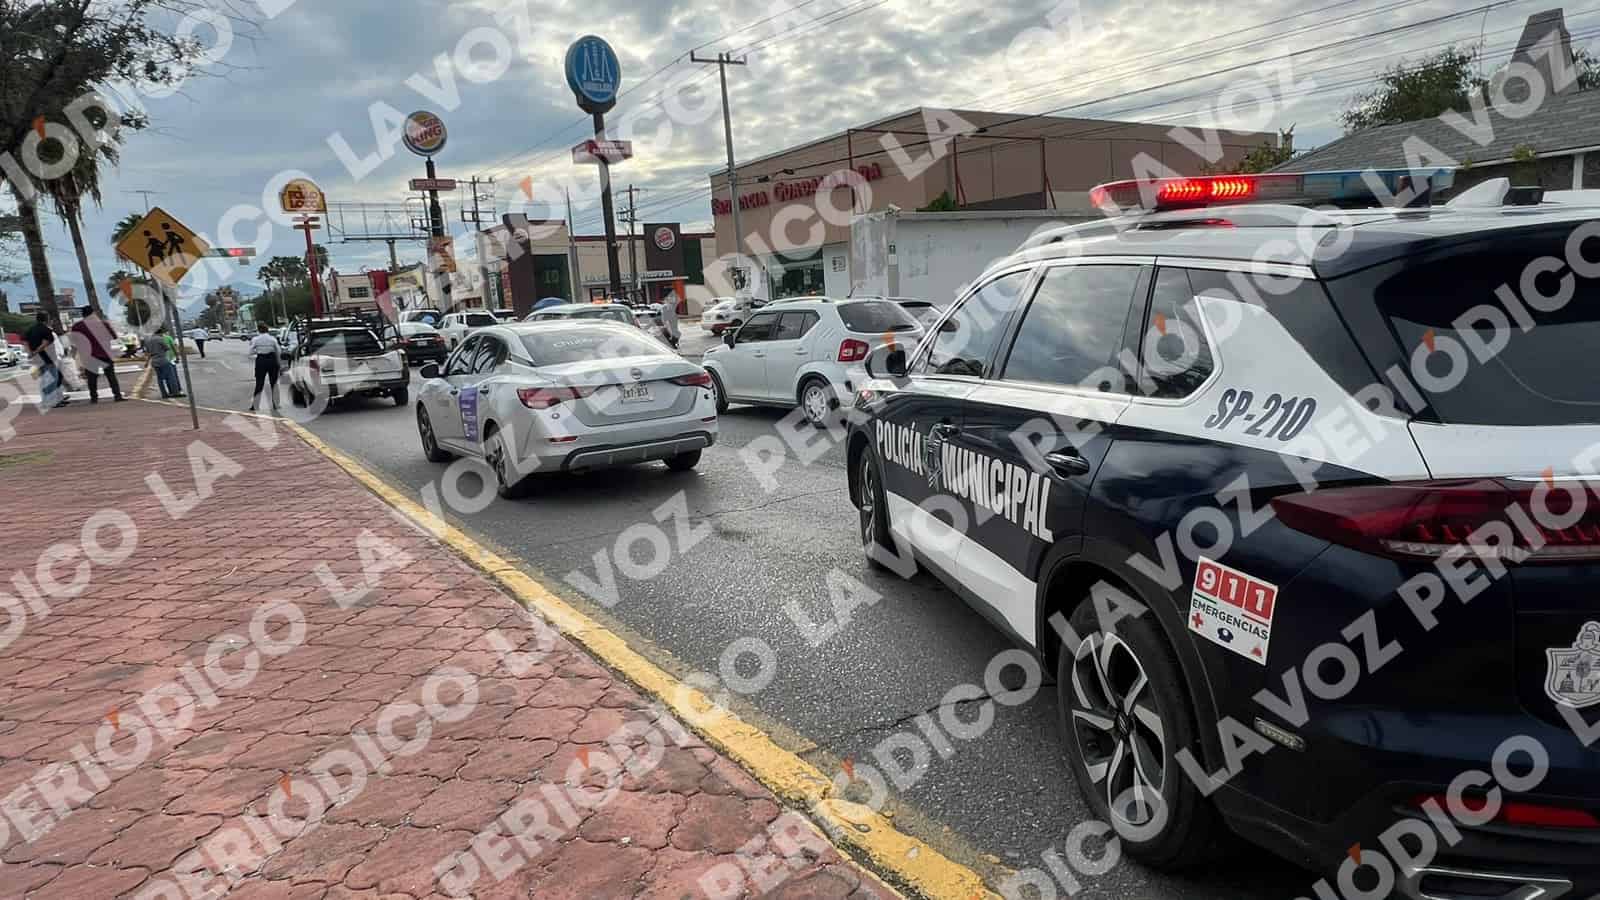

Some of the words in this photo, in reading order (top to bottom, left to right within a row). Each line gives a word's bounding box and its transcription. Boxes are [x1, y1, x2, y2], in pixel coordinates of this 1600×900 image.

[711, 191, 768, 216] FARACIA
[1204, 388, 1317, 441] SP-210
[876, 419, 924, 476] POLICÍA
[941, 442, 1055, 544] MUNICIPAL
[1202, 568, 1265, 612] 911
[1192, 599, 1269, 640] EMERGENCIAS
